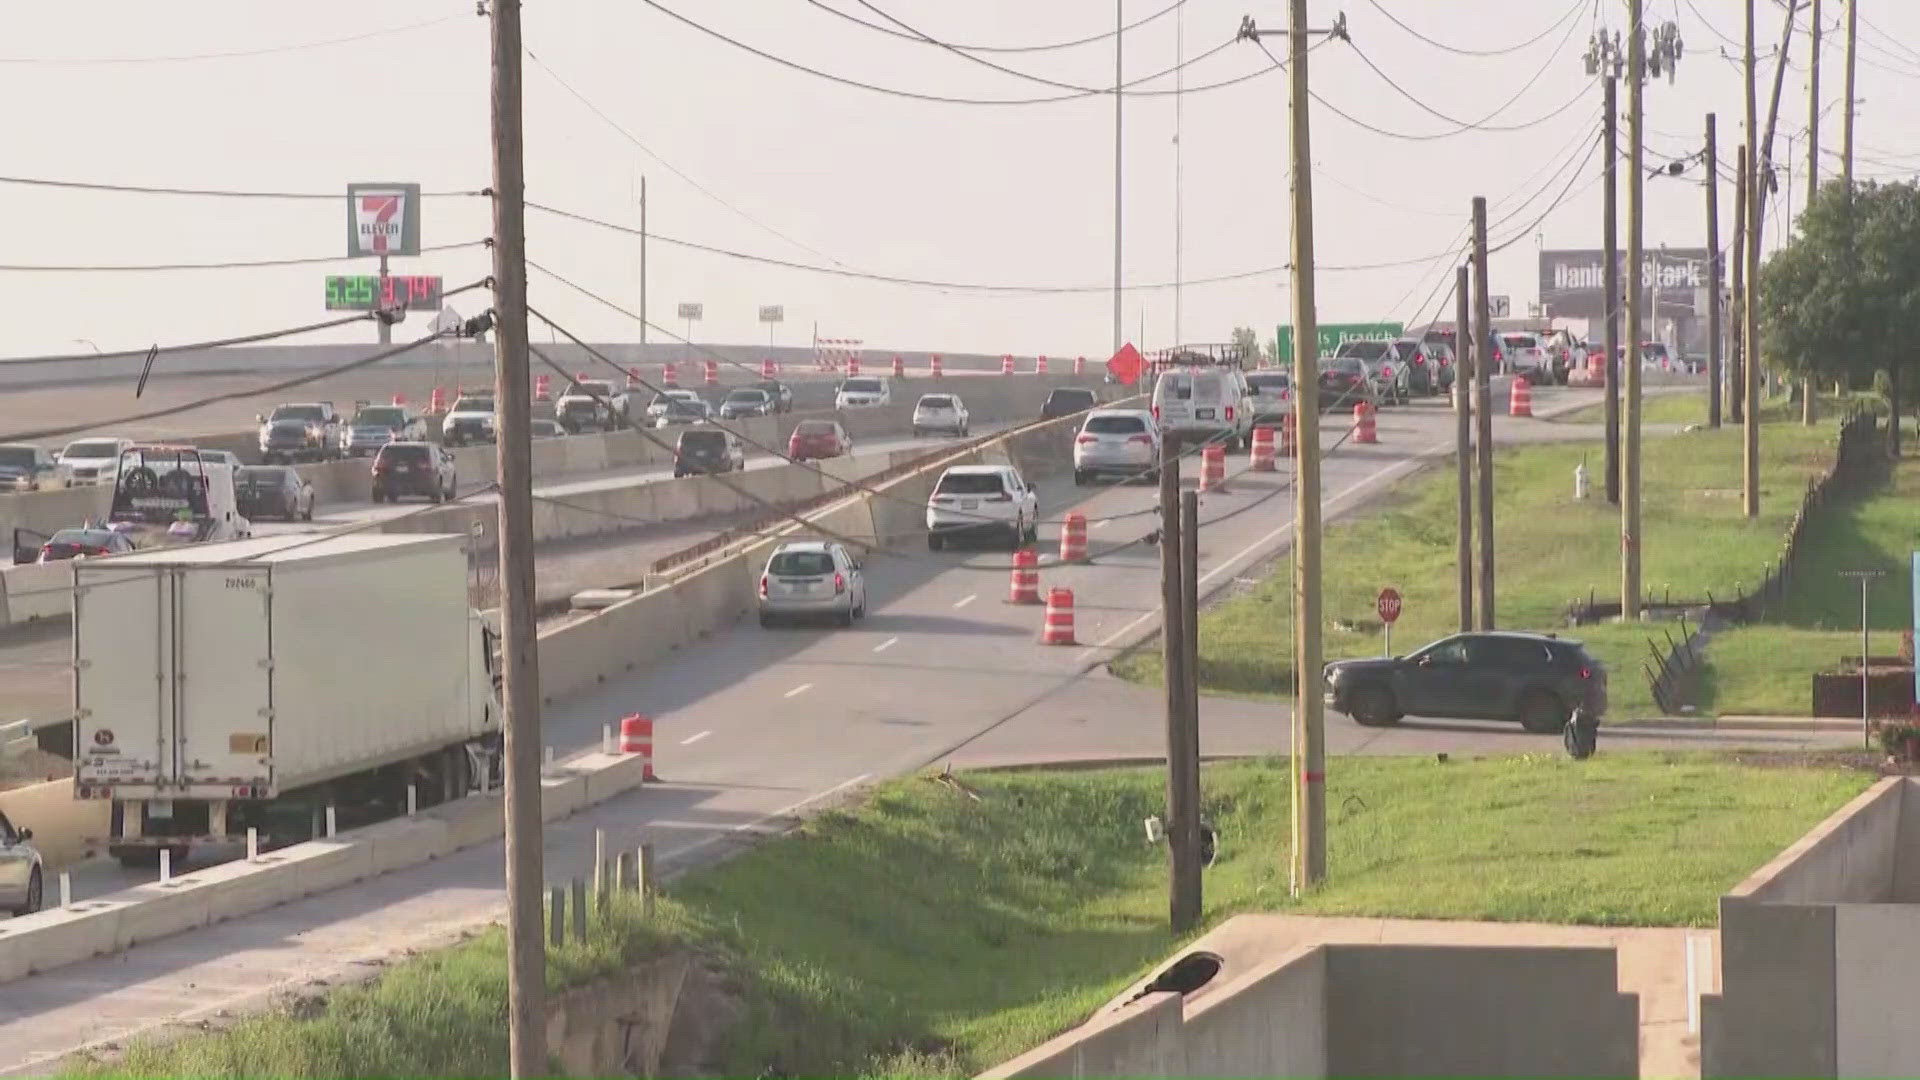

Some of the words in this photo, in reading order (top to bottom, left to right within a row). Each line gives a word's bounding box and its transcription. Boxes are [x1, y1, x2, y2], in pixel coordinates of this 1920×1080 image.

[361, 223, 399, 235] ELEVEN
[1555, 263, 1604, 288] Dani
[1641, 259, 1700, 288] Stark
[1340, 329, 1393, 343] Branch
[1380, 599, 1400, 612] STOP
